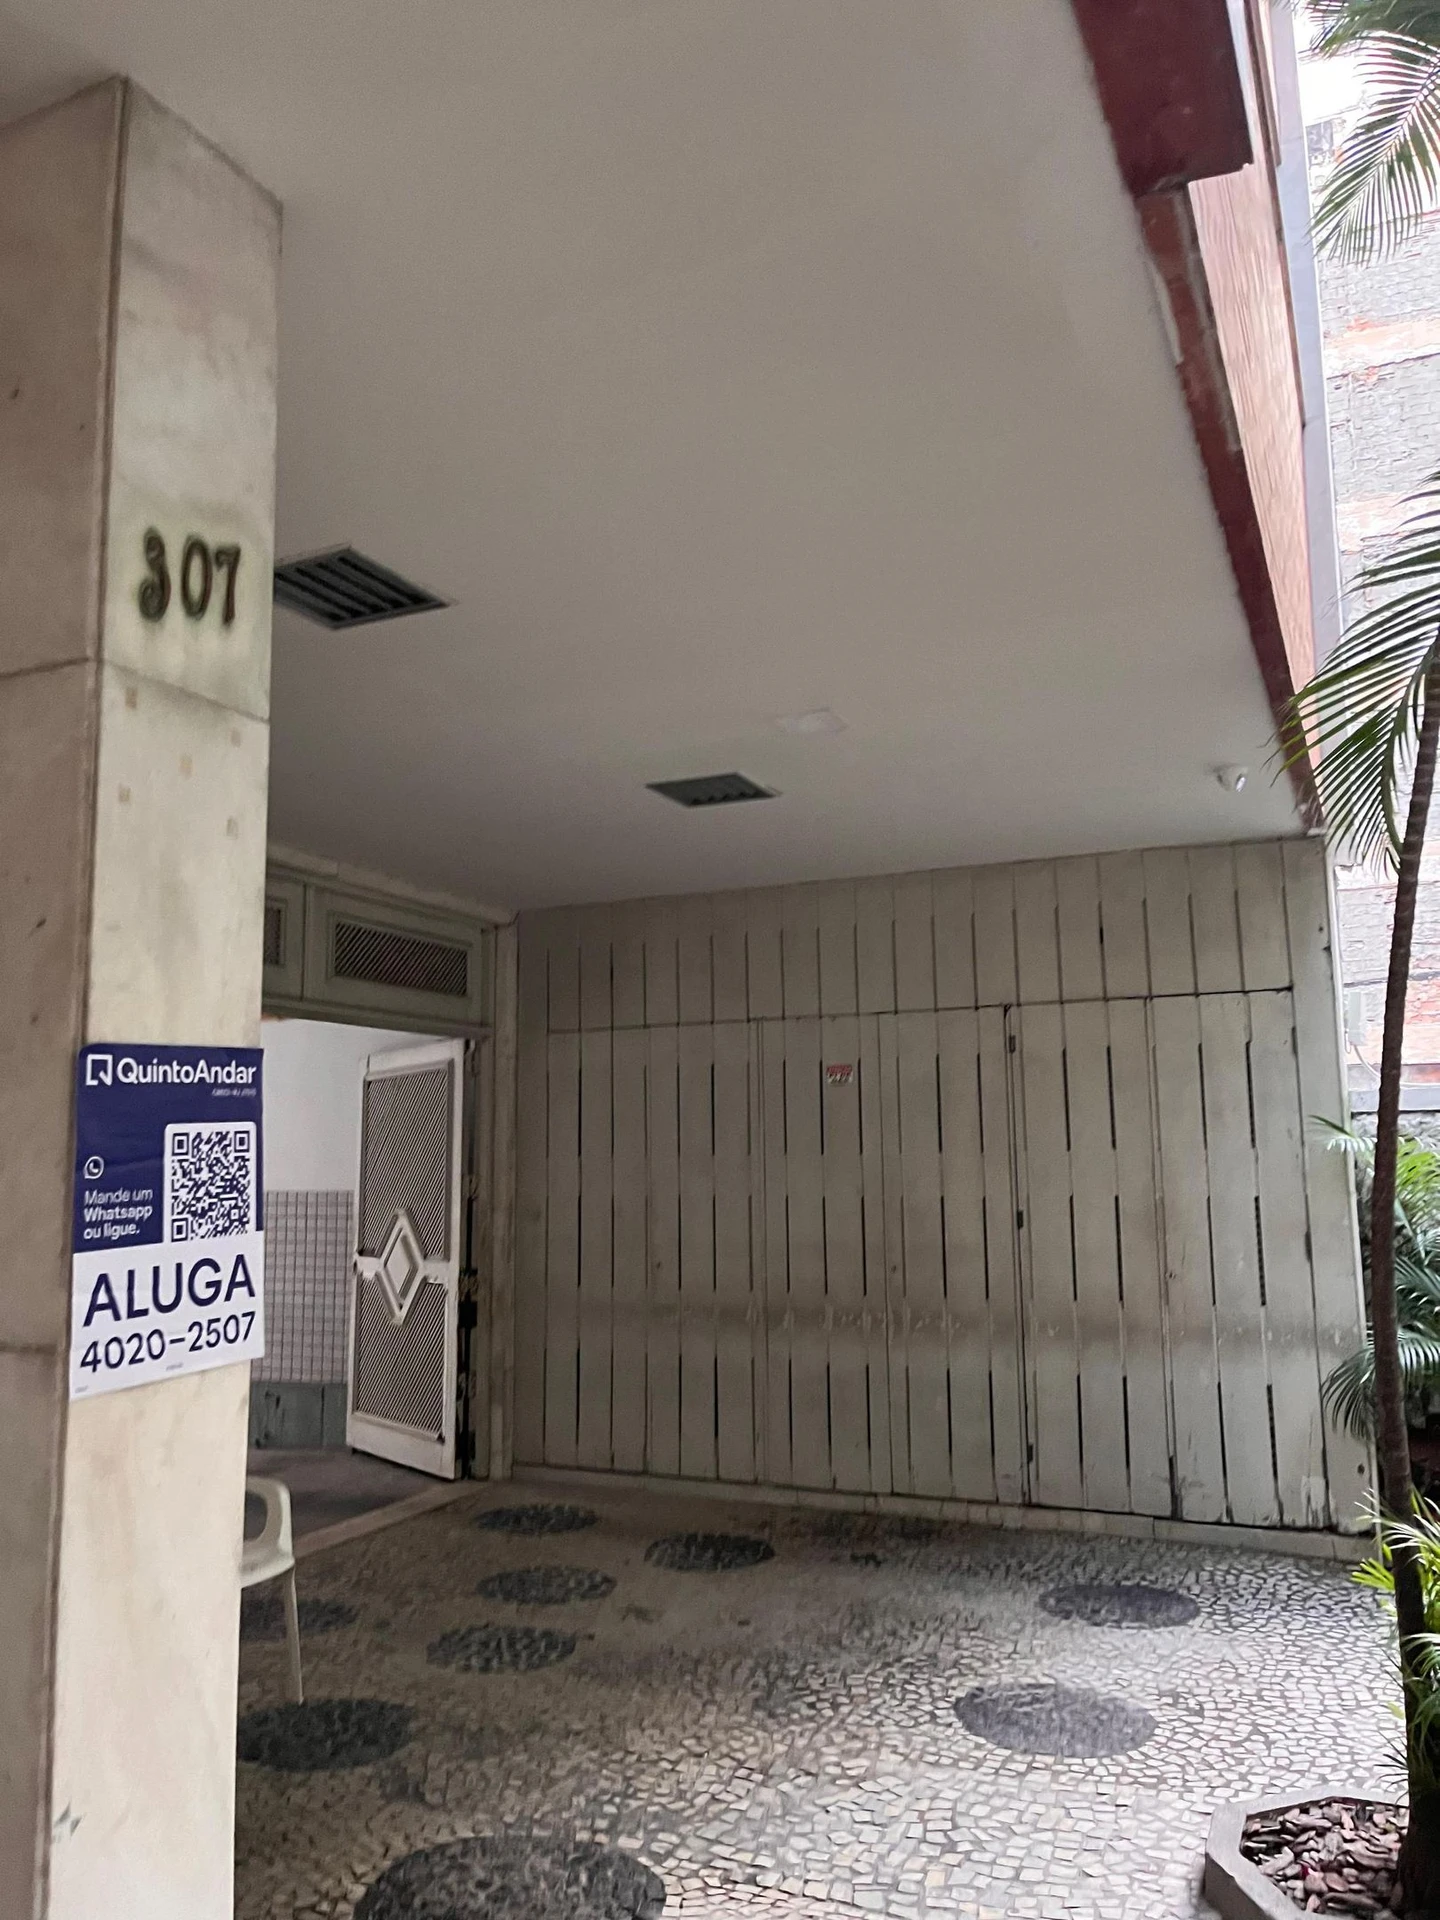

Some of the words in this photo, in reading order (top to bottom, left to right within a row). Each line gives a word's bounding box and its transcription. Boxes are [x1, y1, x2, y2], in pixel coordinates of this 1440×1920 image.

[138, 526, 241, 627] 307
[116, 1057, 257, 1084] QuintoAndar
[84, 1188, 130, 1204] Mande
[131, 1188, 153, 1201] um
[83, 1205, 153, 1222] Whatsapp
[83, 1226, 100, 1240] ou
[103, 1221, 140, 1240] ligue.
[83, 1254, 256, 1327] ALUGA
[80, 1311, 256, 1373] 4020-2507
